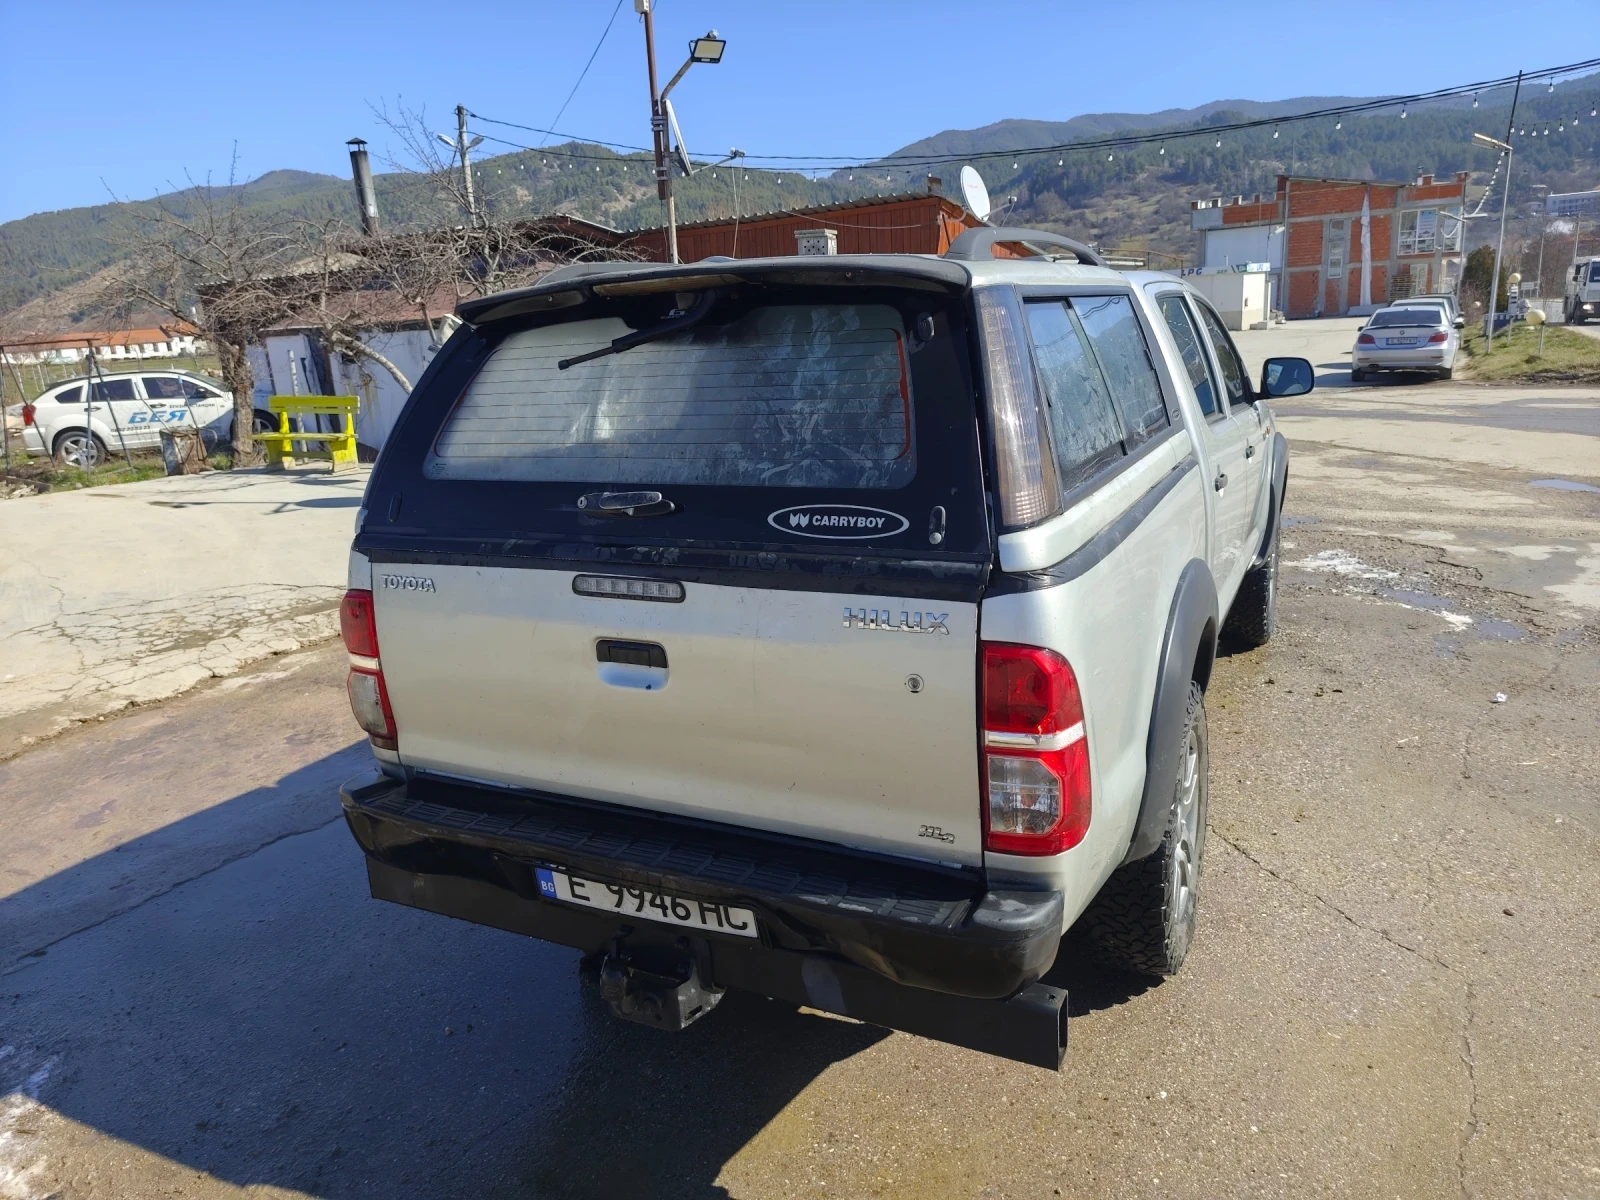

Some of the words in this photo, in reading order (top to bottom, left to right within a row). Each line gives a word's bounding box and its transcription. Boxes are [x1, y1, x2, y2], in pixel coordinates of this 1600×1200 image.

[1181, 267, 1203, 277] LPG
[128, 409, 188, 424] БЕЯ
[812, 515, 885, 529] CARRYBOY
[381, 573, 437, 593] TOYOTA
[843, 607, 949, 635] HILUX
[541, 880, 555, 893] BG
[567, 875, 591, 902] E
[605, 883, 691, 921] 9946
